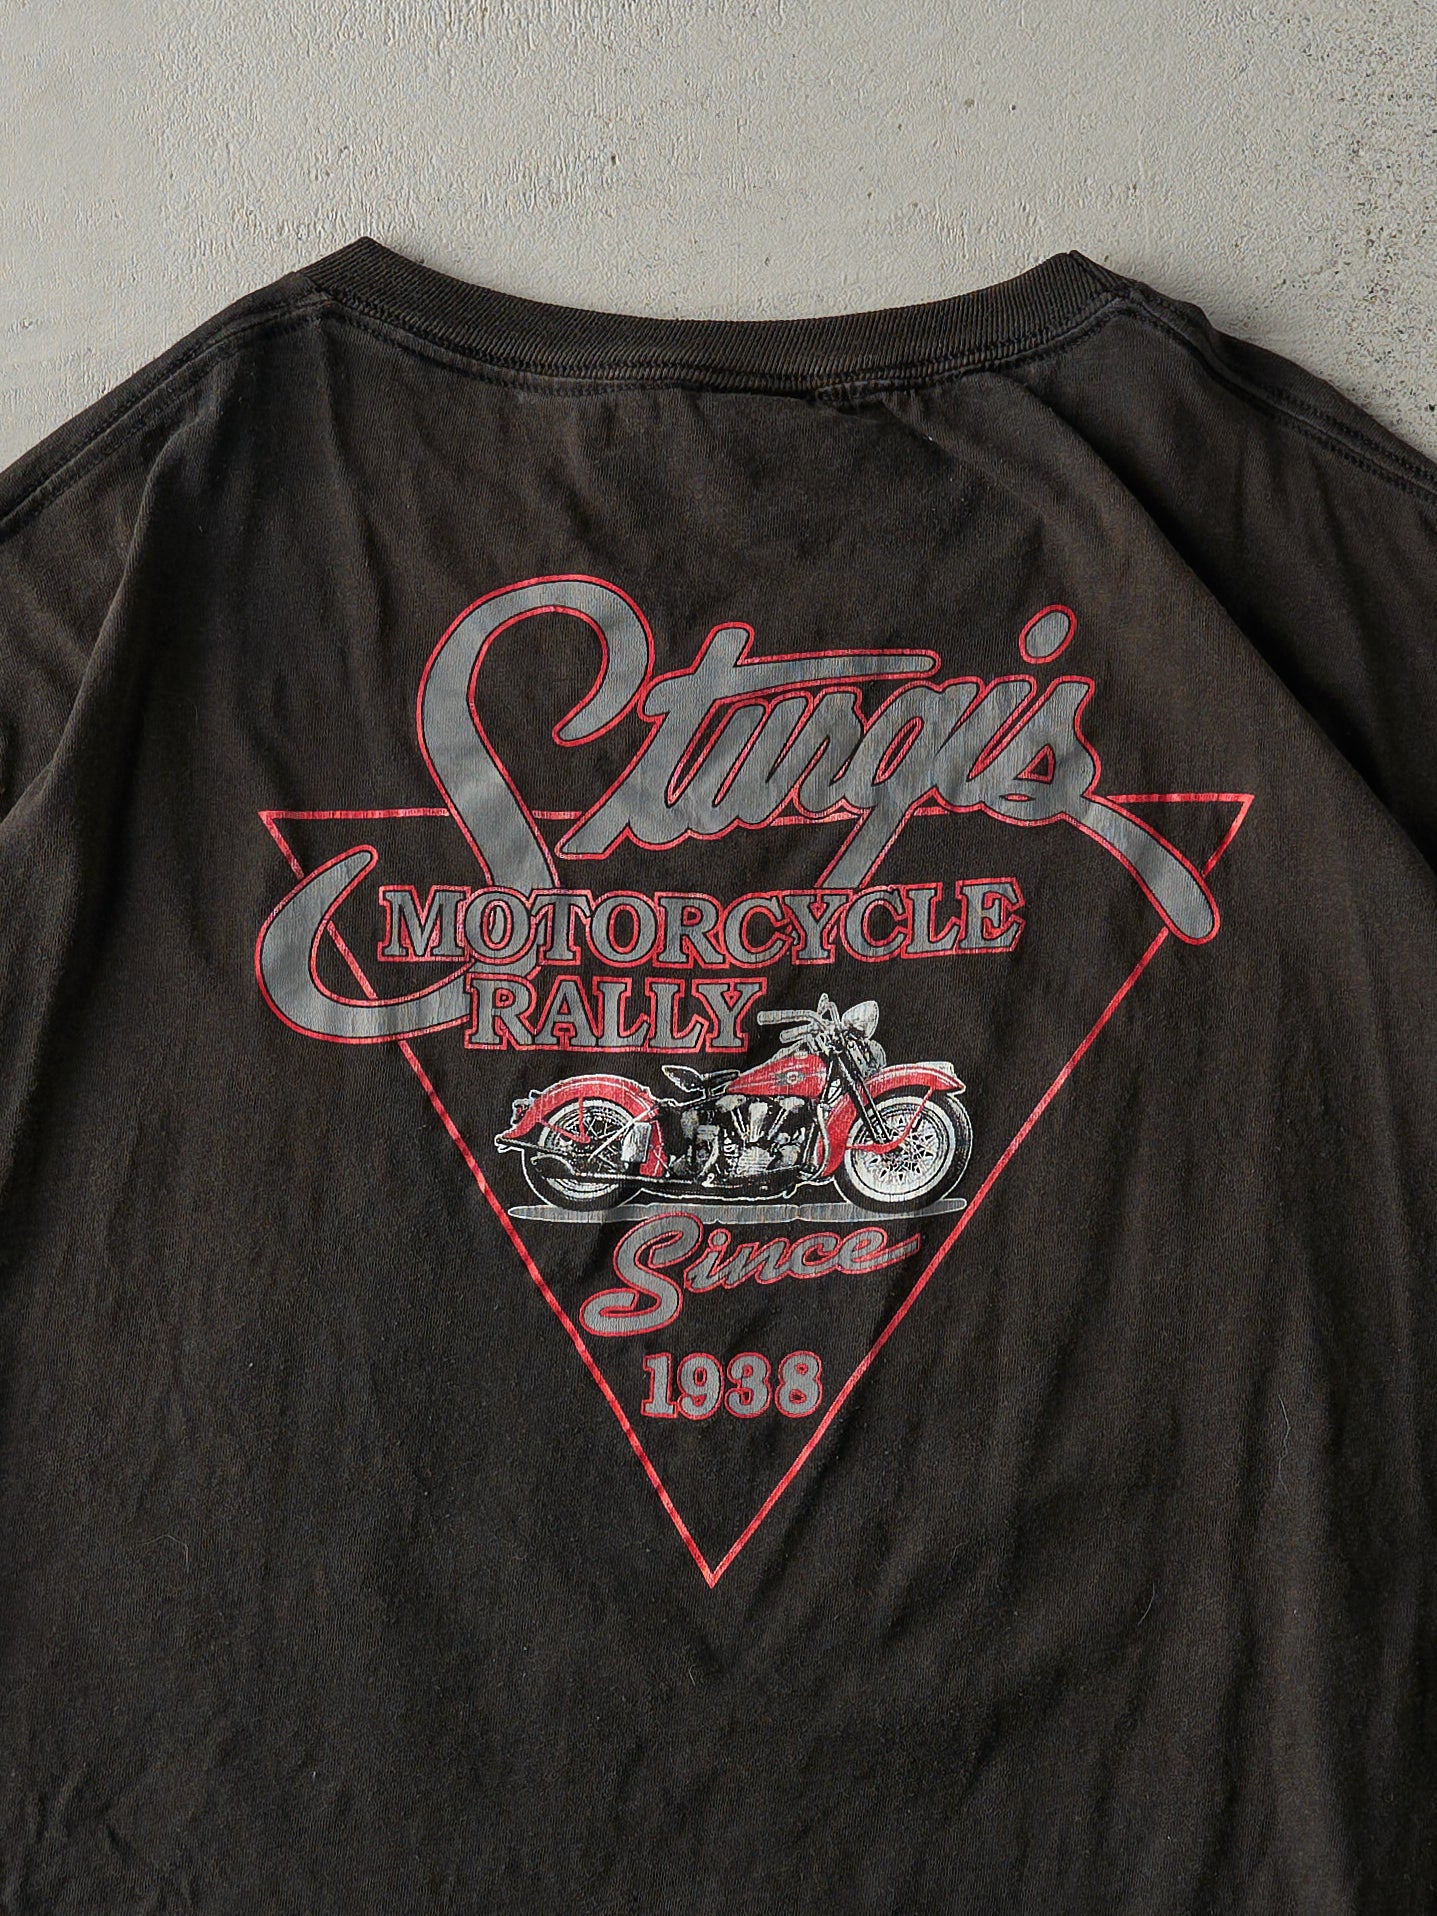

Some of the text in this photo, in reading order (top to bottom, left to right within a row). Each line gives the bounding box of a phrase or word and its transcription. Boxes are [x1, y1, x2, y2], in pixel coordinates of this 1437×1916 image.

[254, 574, 1222, 1045] Sturgis
[377, 876, 1025, 970] MOTORCYCLE
[463, 975, 767, 1054] RALLY
[580, 1212, 921, 1337] Since
[641, 1351, 823, 1420] 1938
